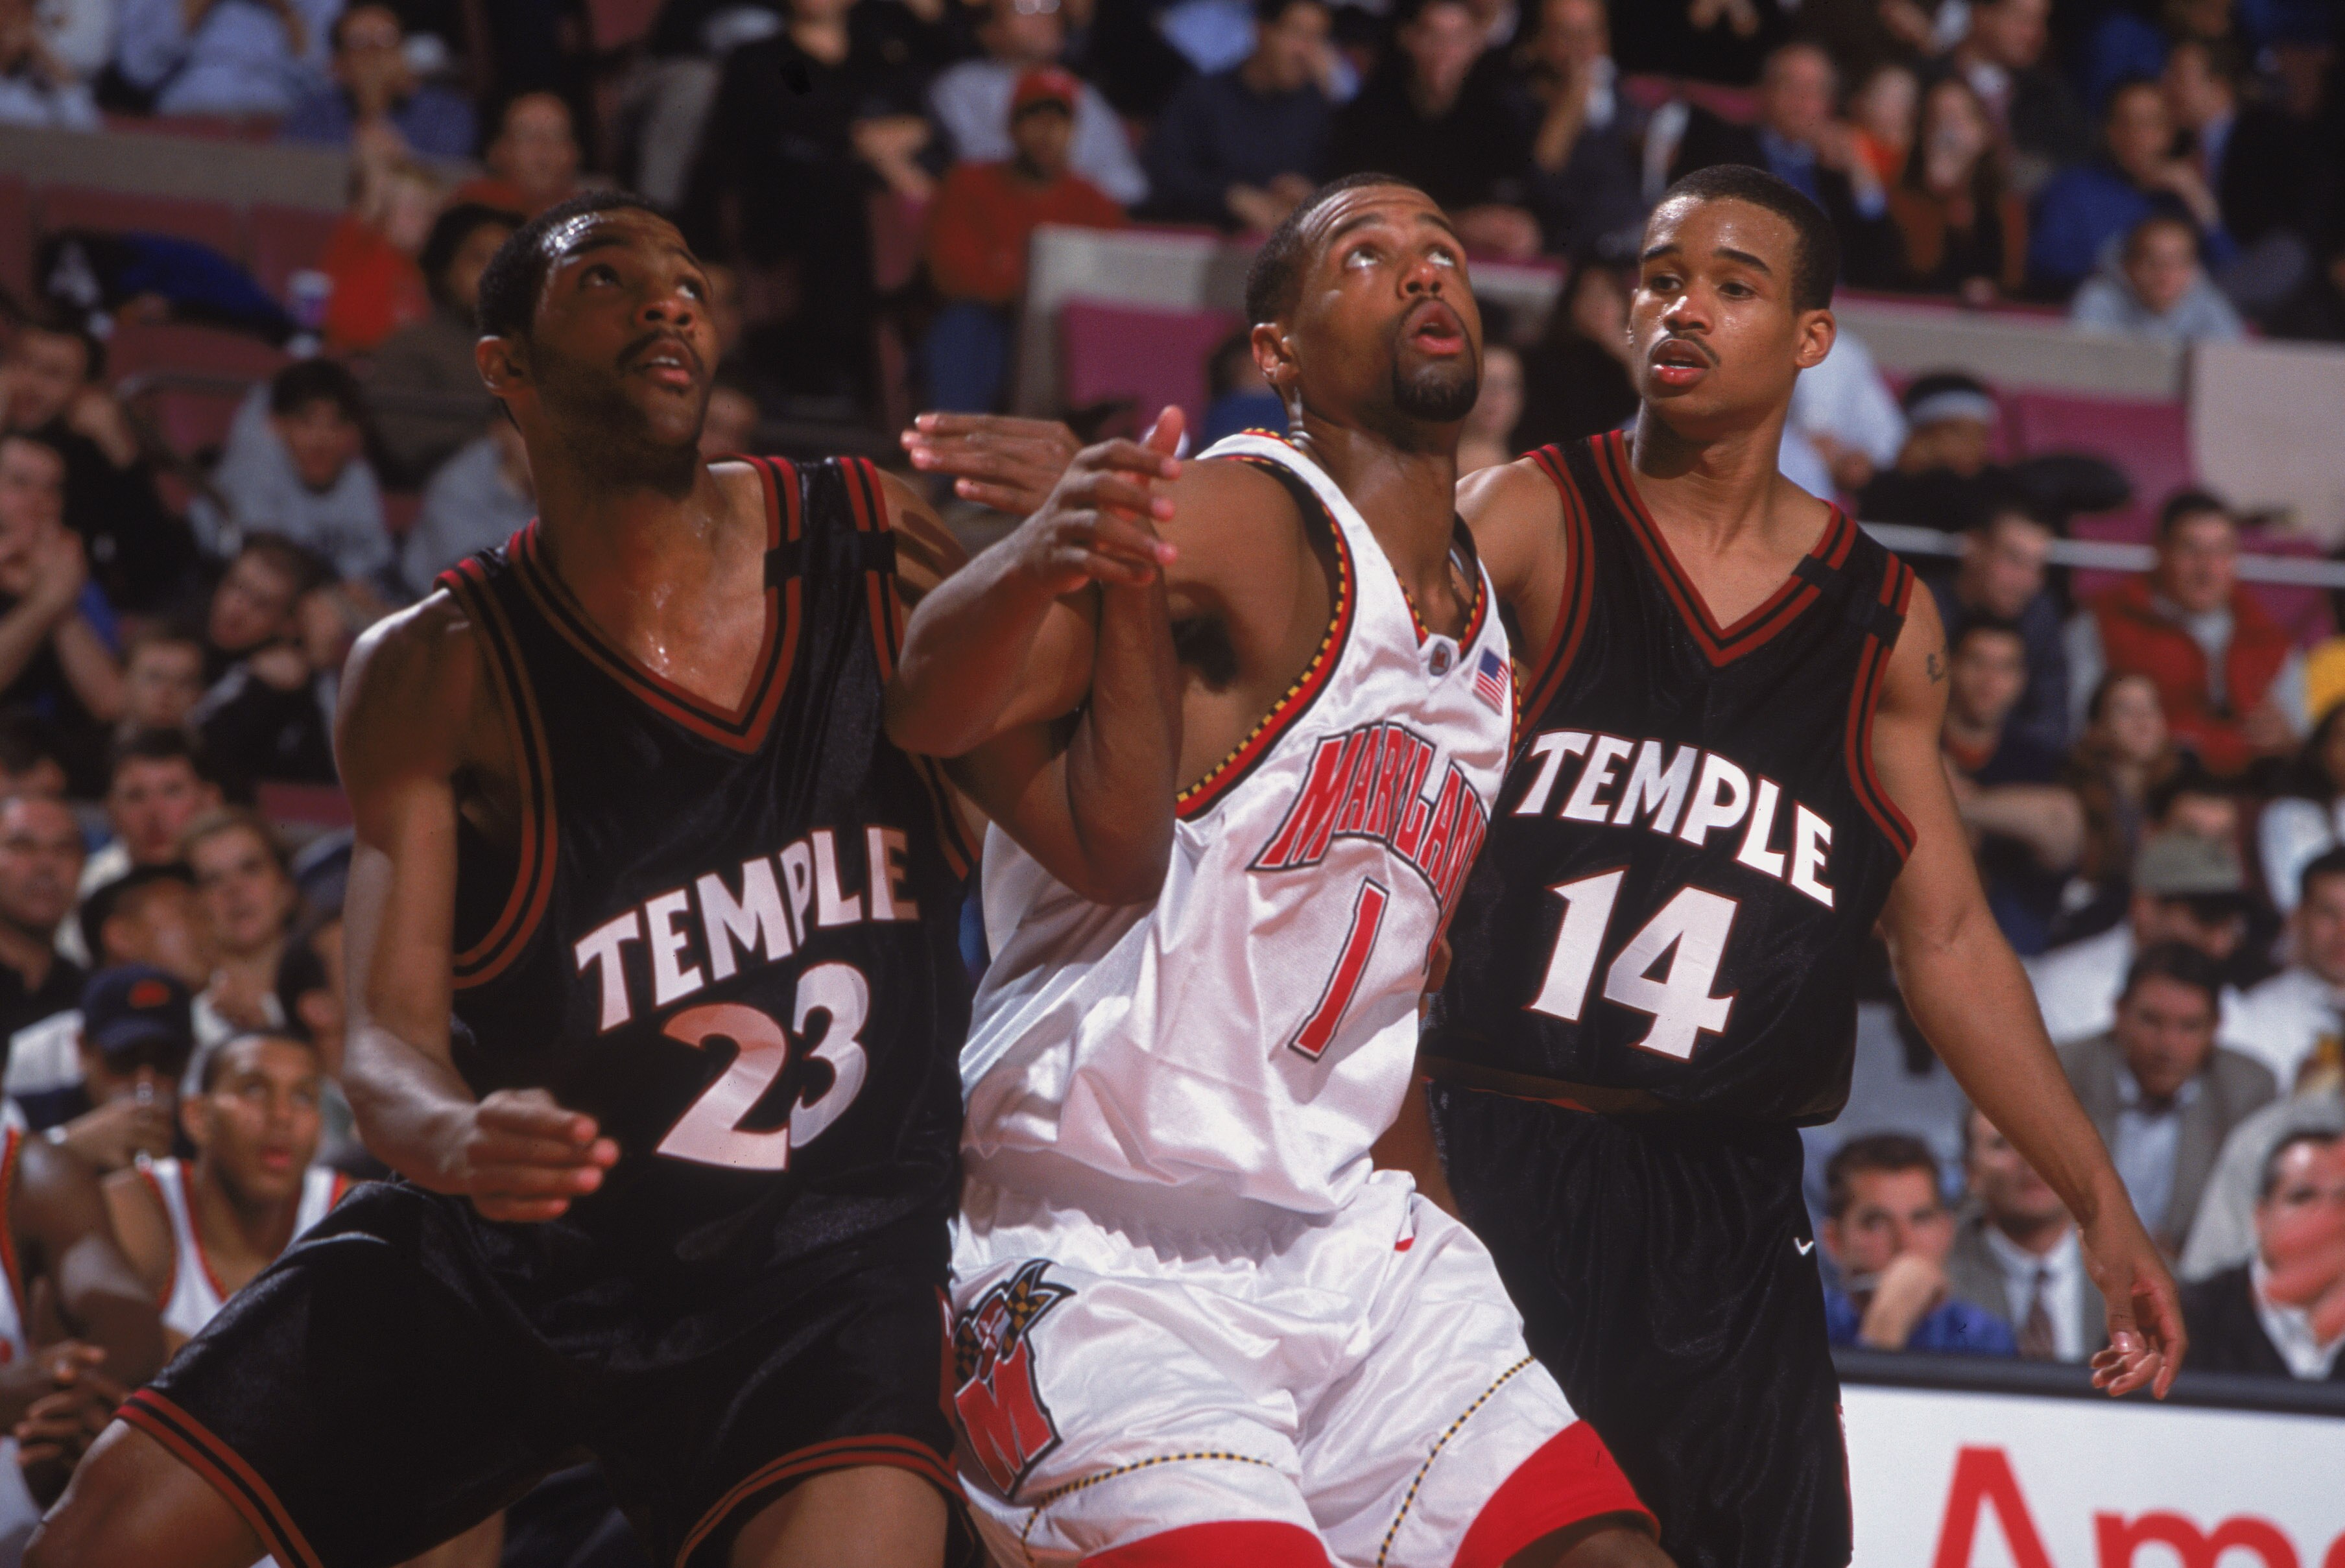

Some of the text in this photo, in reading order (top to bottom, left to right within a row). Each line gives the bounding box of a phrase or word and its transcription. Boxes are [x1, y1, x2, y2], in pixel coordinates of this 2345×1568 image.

[1509, 728, 1836, 912] TEMPLE
[573, 824, 921, 1035] TEMPLE
[1287, 876, 1390, 1062] 1
[1521, 864, 1742, 1064] 14
[652, 961, 871, 1172] 23
[1931, 1443, 2345, 1568] Am
